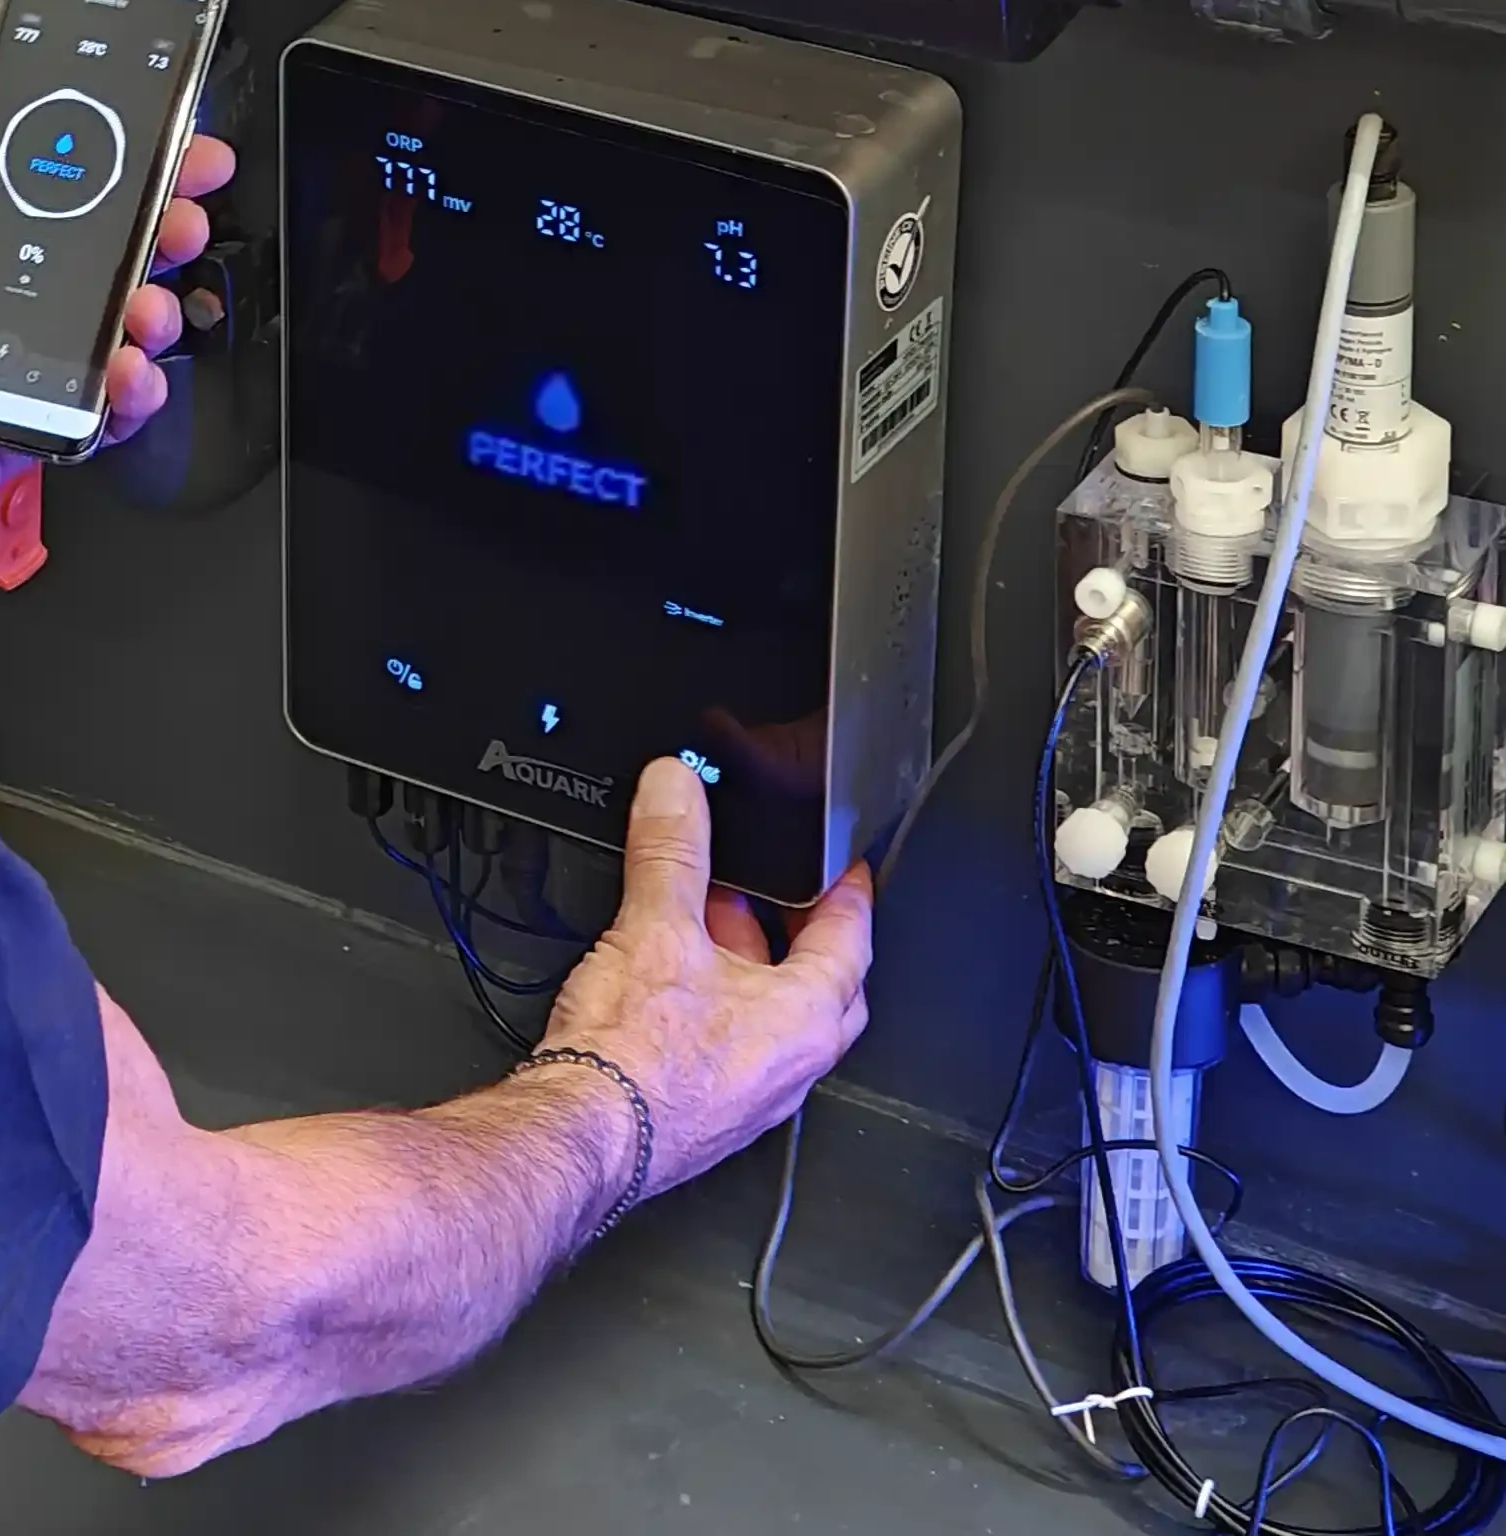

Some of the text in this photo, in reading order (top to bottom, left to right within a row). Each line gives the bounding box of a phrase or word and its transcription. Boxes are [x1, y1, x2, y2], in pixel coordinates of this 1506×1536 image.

[386, 132, 423, 152] ORP
[29, 158, 87, 180] PERFECT
[375, 156, 436, 200] 777
[536, 199, 580, 242] 28
[716, 218, 744, 239] pH
[18, 243, 45, 265] 0%
[704, 242, 757, 289] 7.3
[467, 430, 647, 507] PERFECT
[477, 739, 613, 808] AQUARK
